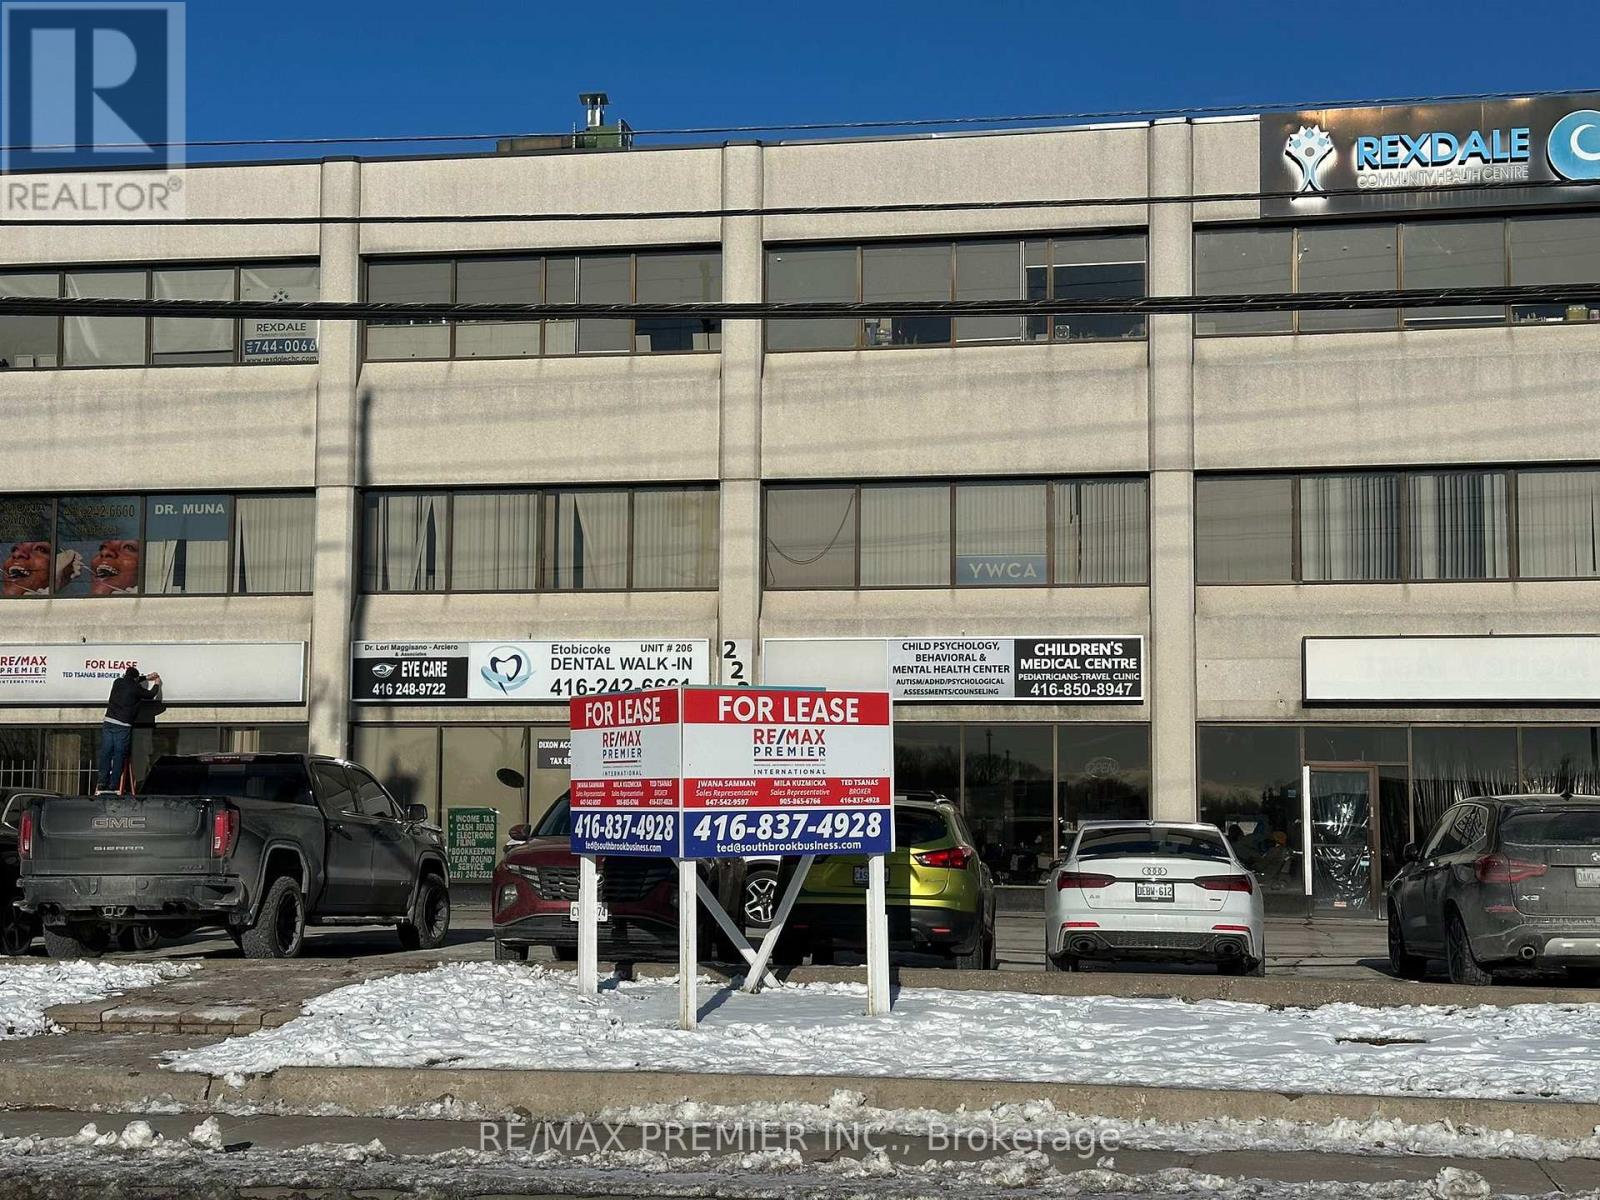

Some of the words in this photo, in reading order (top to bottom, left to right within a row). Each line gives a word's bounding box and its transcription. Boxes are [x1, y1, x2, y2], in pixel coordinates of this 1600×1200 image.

[1357, 128, 1530, 170] REXDALE
[1358, 170, 1436, 188] COMMUNITY
[1437, 168, 1481, 185] HEALTH
[1483, 165, 1529, 182] CENTRE
[256, 322, 306, 332] REXDALE
[254, 340, 316, 353] 744-0066
[154, 504, 178, 515] DR.
[182, 503, 225, 514] MUNA
[968, 562, 1037, 579] YWCA
[551, 644, 611, 655] Etobicoke
[640, 644, 664, 653] UNIT
[666, 644, 673, 653] #
[675, 644, 693, 653] 206
[901, 641, 932, 651] CHILD
[933, 641, 1000, 652] PSYCHOLOGY,
[1034, 640, 1123, 656] CHILDREN'S
[0, 656, 47, 666] RE/MAX
[915, 653, 975, 662] BEHAVIORAL
[978, 653, 987, 662] &
[85, 660, 105, 669] FOR
[401, 660, 420, 677] EYE
[422, 660, 448, 677] CARE
[551, 657, 615, 670] DENTAL
[892, 665, 931, 674] MENTAL
[933, 665, 970, 674] HEALTH
[972, 664, 1010, 674] CENTER
[1020, 658, 1081, 670] MEDICAL
[1084, 657, 1137, 669] CENTRE
[896, 677, 1005, 686] AUTISM/ADHD/PSYCHOLOGICAL
[1018, 672, 1111, 681] PEDIATRICIANS-TRAVEL
[1113, 672, 1140, 681] CLINIC
[372, 682, 393, 695] 416
[395, 682, 446, 695] 248-9722
[1030, 682, 1133, 696] 416-850-8947
[585, 701, 613, 727] FOR
[617, 697, 661, 725] LEASE
[718, 695, 774, 722] FOR
[783, 696, 859, 723] LEASE
[602, 730, 641, 747] RE/MAX
[753, 728, 826, 745] RE/MAX
[538, 741, 559, 749] DIXON
[602, 748, 642, 759] PREMIER
[753, 747, 826, 757] PREMIER
[550, 757, 563, 765] TAX
[709, 789, 758, 798] Representative
[784, 788, 830, 797] Representative
[91, 816, 147, 829] GMC
[483, 815, 495, 823] TAX
[456, 823, 474, 831] CASH
[575, 813, 674, 841] 416-837-4928
[693, 812, 882, 841] 416-837-4928
[456, 831, 494, 839] ELECTRONIC
[585, 840, 662, 853] ted@southbrookbusiness.com
[716, 841, 861, 853] ted@southbrookbusiness.com
[450, 855, 468, 863] YEAR
[470, 855, 492, 863] ROUND
